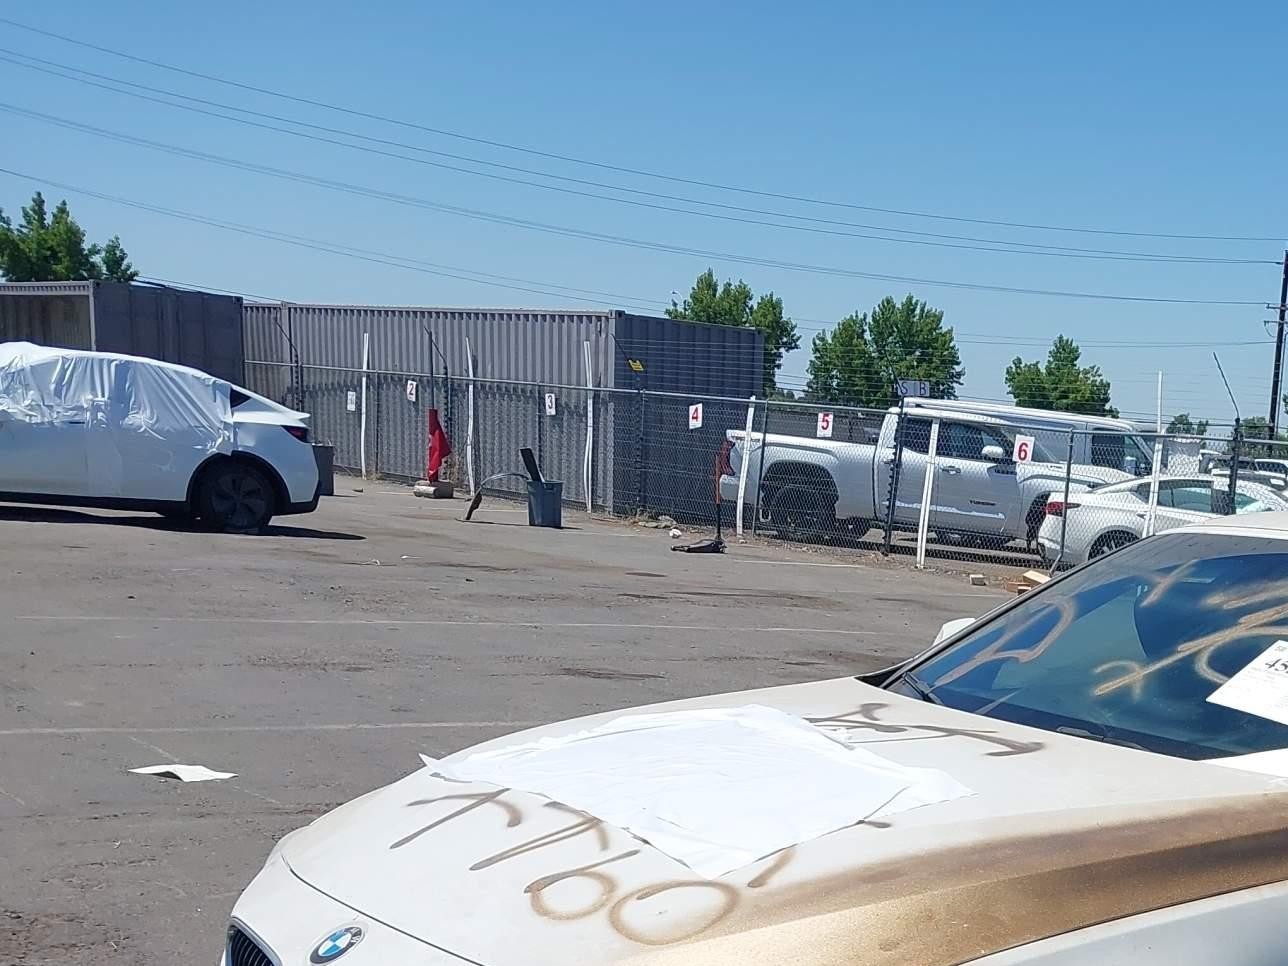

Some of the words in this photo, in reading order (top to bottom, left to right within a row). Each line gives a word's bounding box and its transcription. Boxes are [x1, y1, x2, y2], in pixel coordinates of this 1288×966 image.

[408, 382, 414, 396] 2
[919, 381, 927, 396] B
[547, 394, 553, 410] 3
[691, 406, 699, 422] 4
[821, 413, 830, 431] 5
[1018, 442, 1029, 461] 6
